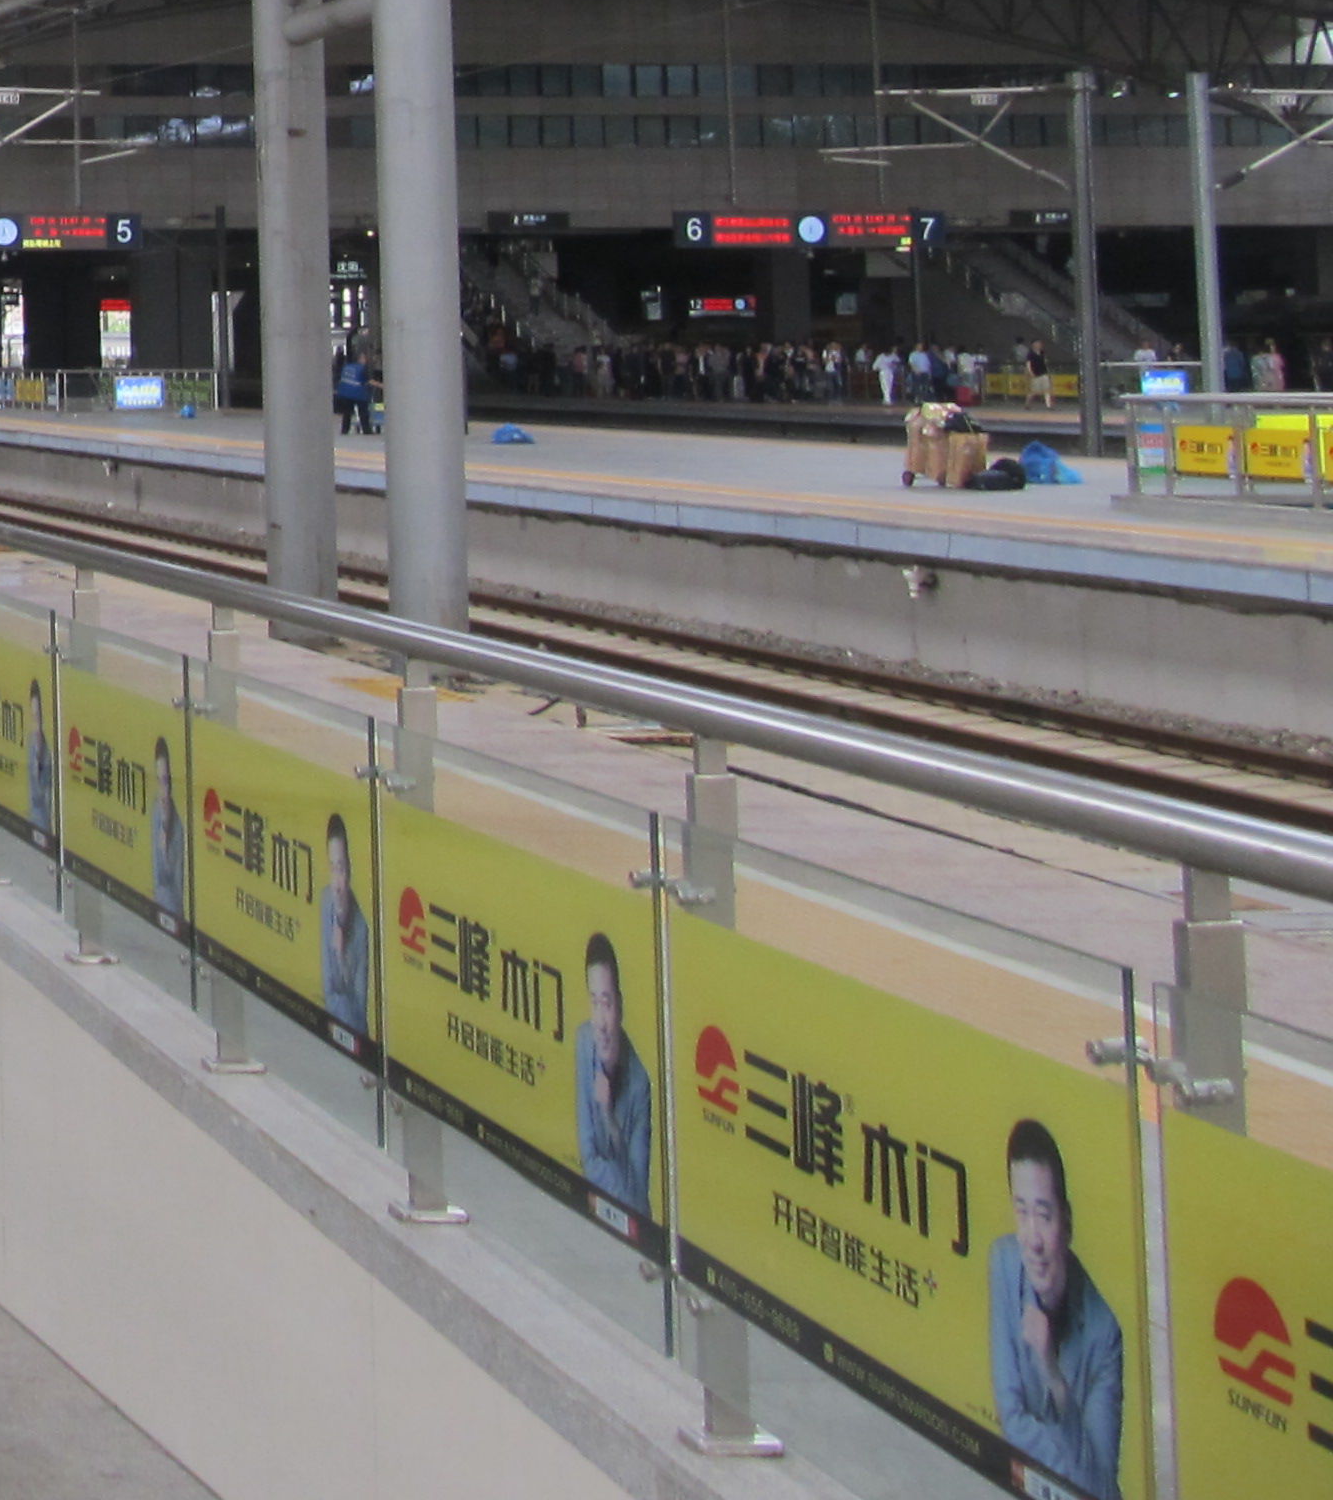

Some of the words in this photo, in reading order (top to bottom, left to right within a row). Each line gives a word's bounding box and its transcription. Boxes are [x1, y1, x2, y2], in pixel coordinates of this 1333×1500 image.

[117, 219, 132, 243] 5
[686, 217, 703, 241] 6
[920, 217, 935, 240] 7
[1227, 1387, 1288, 1433] SUNFUN
